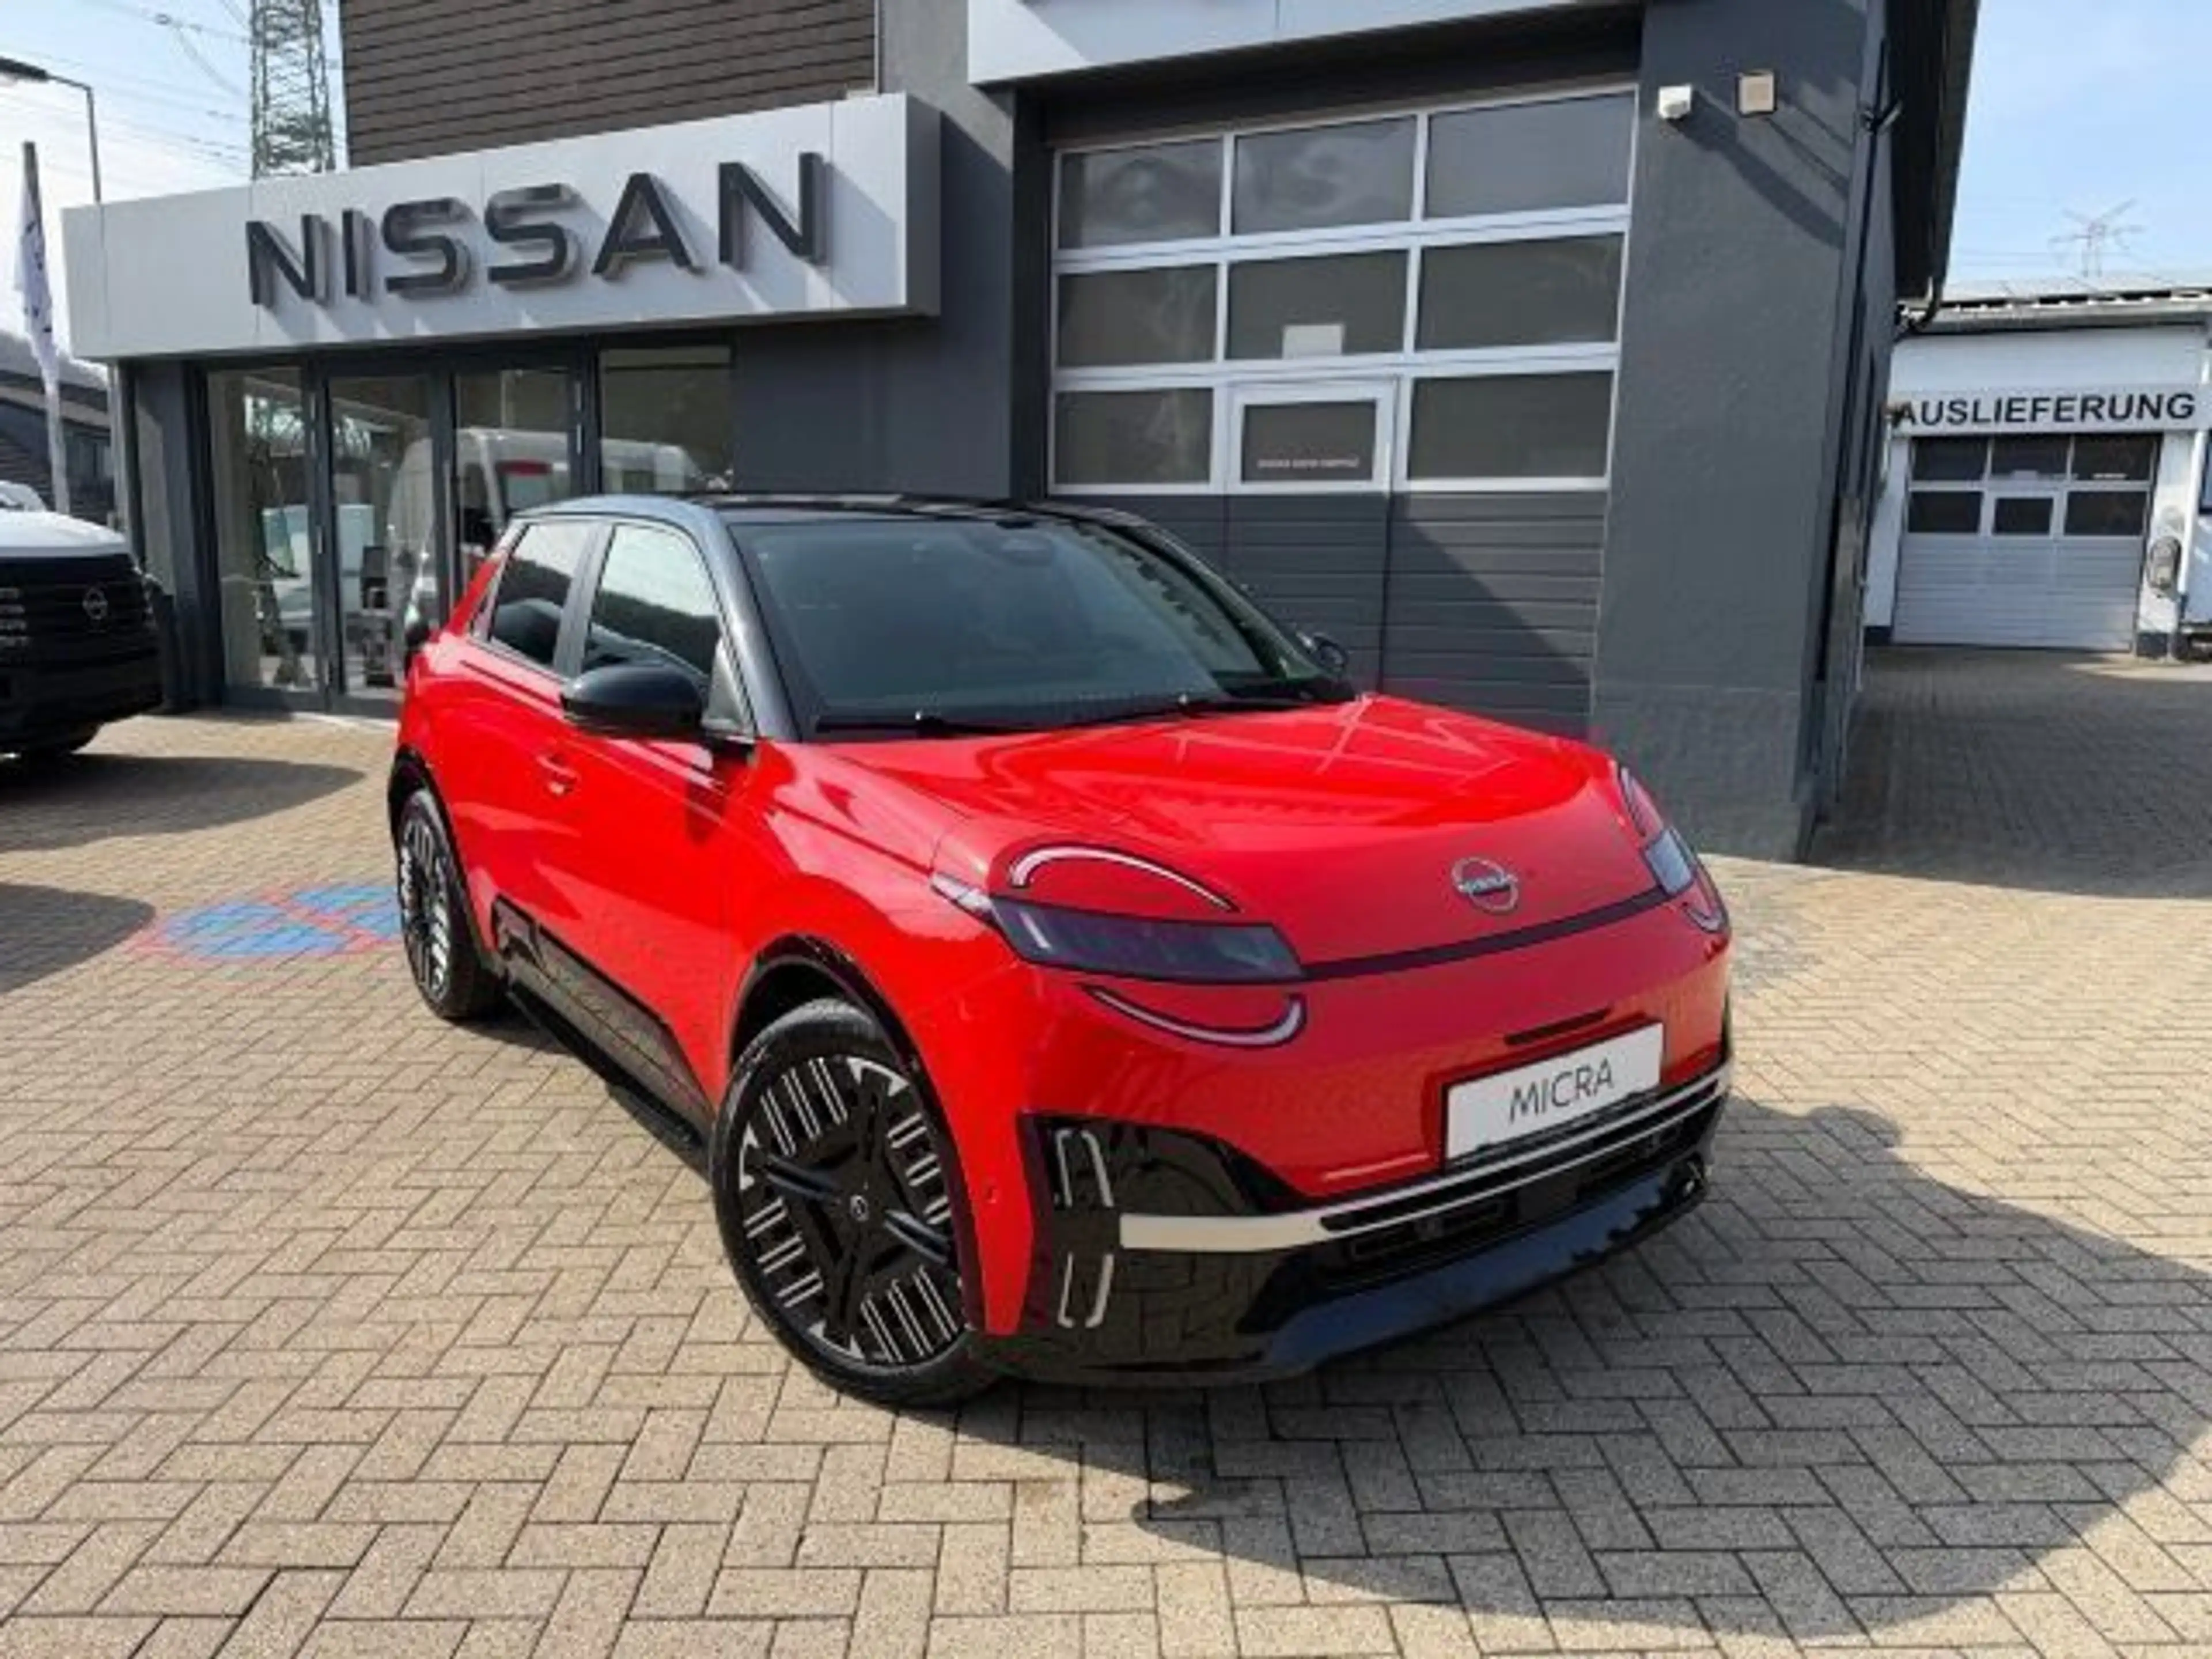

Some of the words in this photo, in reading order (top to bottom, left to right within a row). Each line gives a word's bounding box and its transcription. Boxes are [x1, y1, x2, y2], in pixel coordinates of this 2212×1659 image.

[245, 151, 826, 305] NISSAN
[1893, 392, 2196, 426] AUSLIEFERUNG
[1509, 1057, 1614, 1123] MICRA
